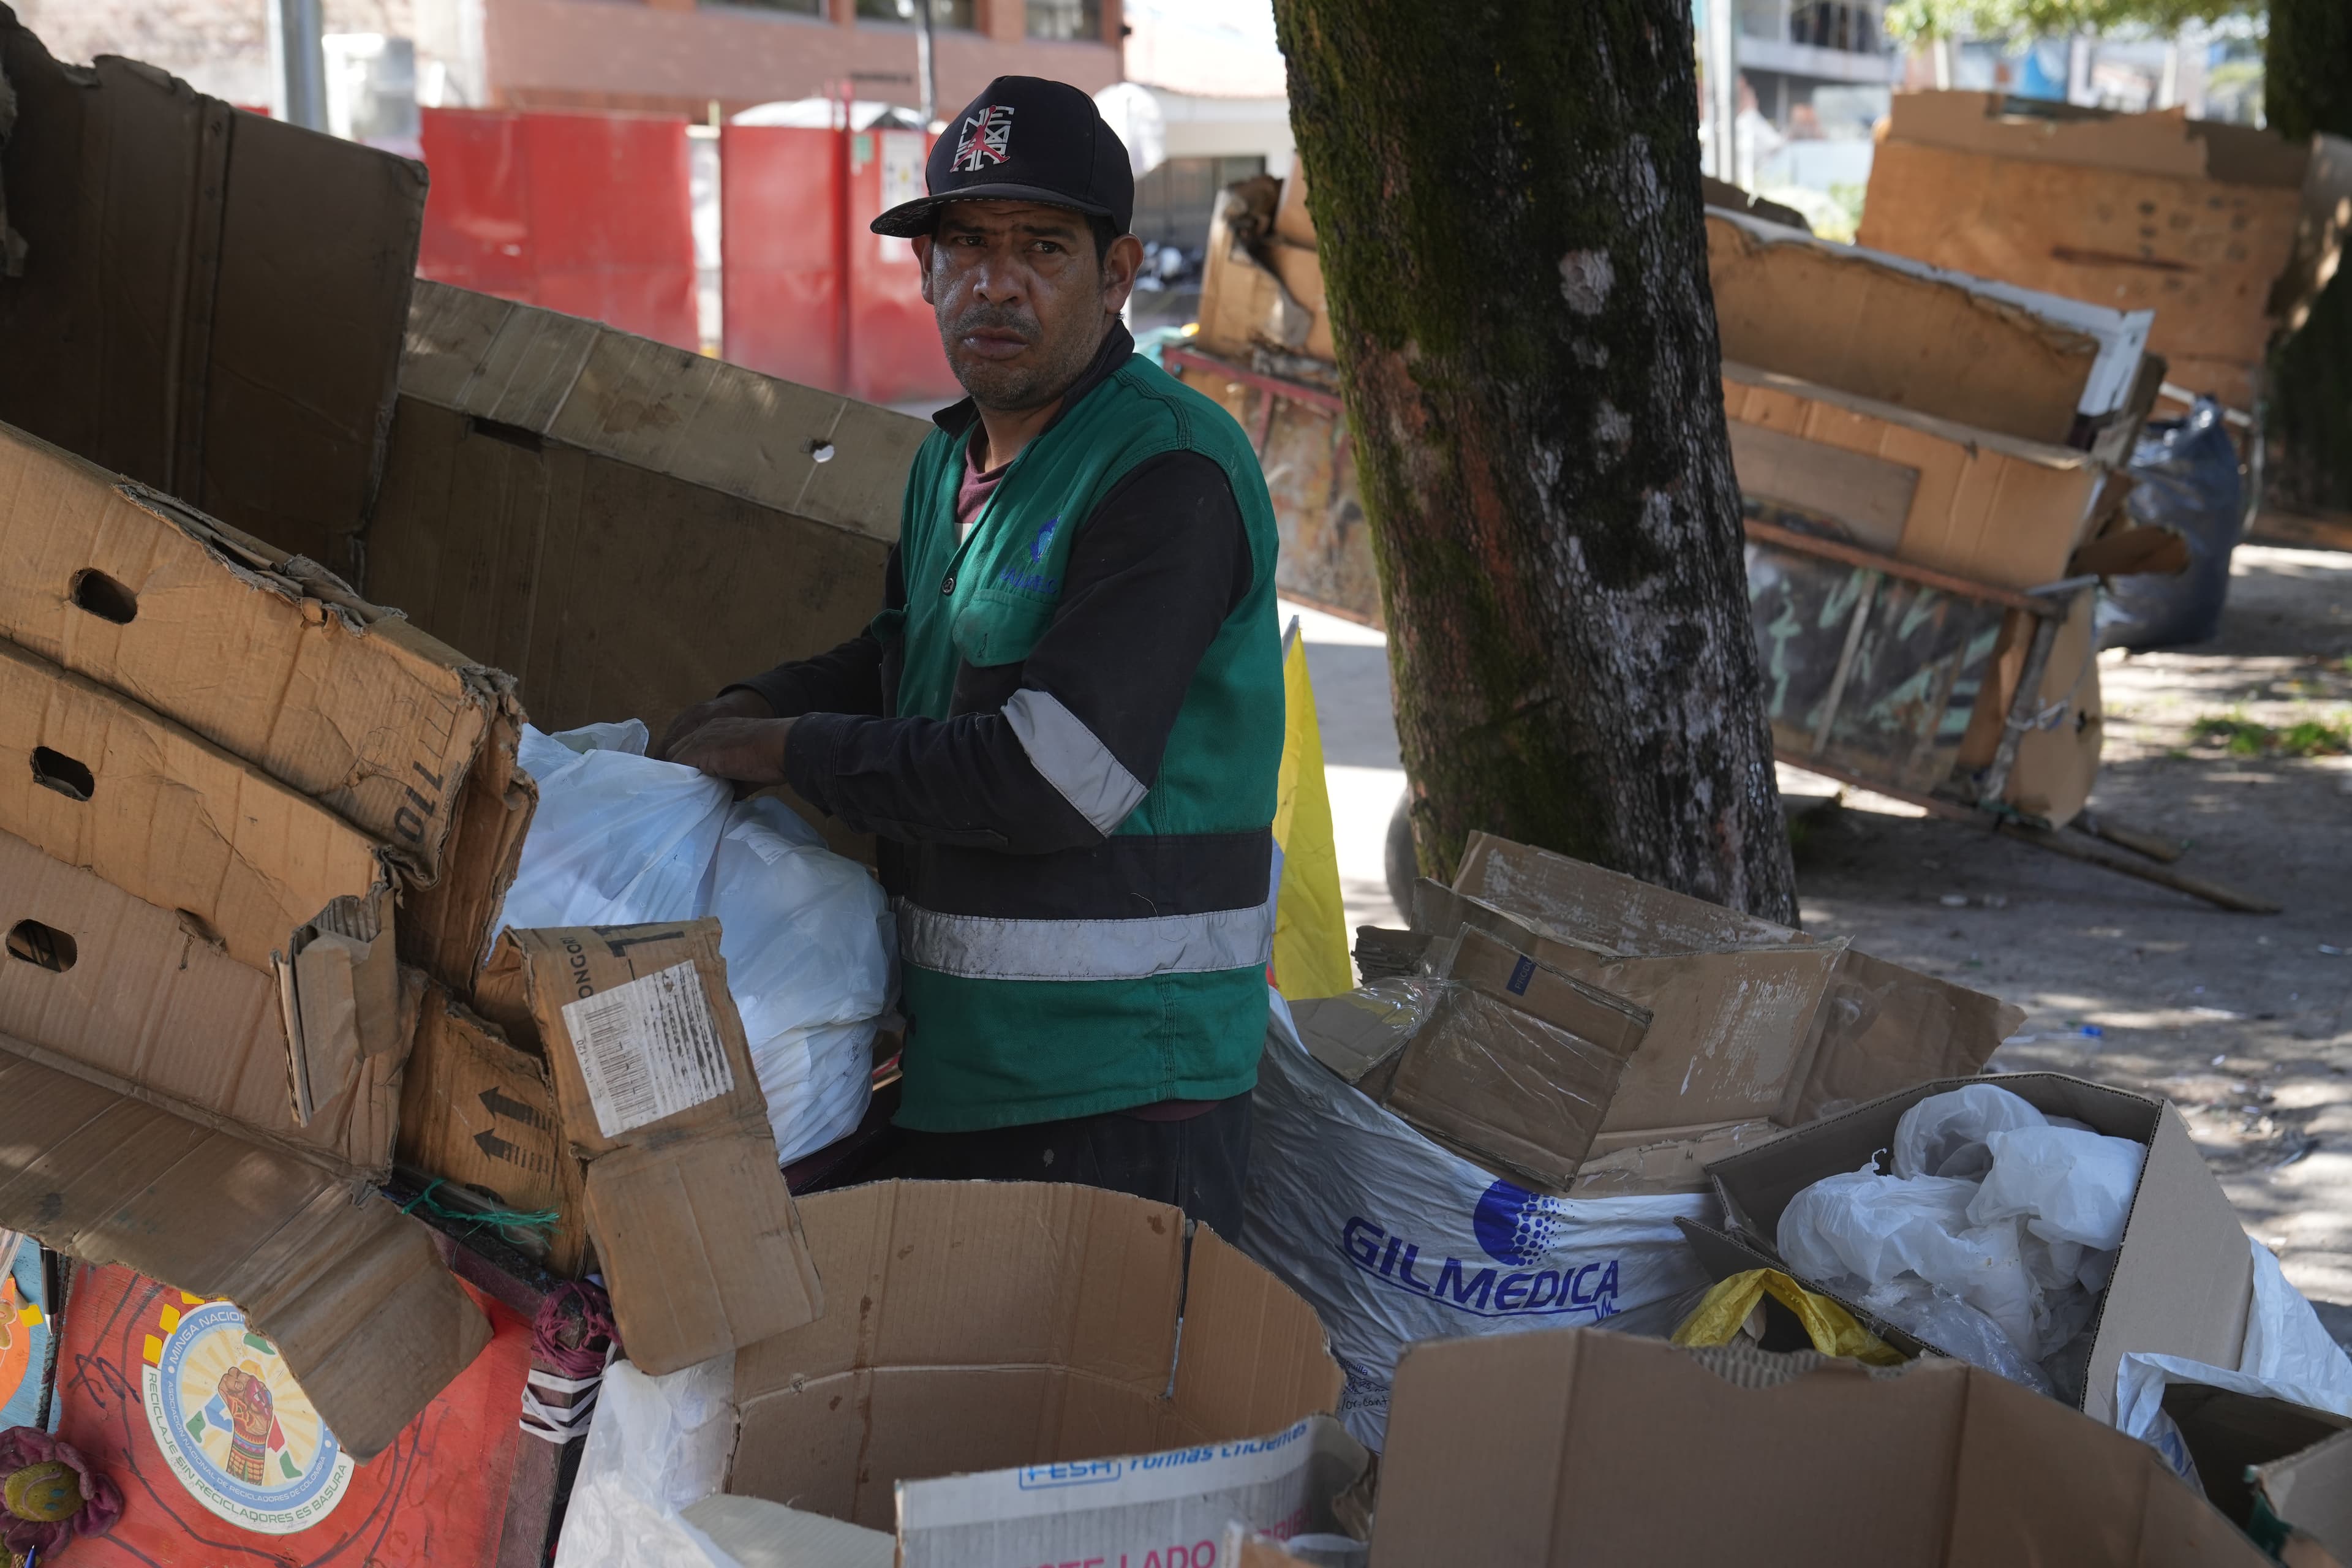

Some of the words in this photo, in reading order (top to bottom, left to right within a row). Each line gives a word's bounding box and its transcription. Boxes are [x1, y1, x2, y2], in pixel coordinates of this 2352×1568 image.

[1343, 1216, 1618, 1311] GILMEDICA
[169, 1324, 200, 1364] MINGA
[149, 1372, 178, 1455] RECICLAJE
[175, 1457, 195, 1480] SIN
[195, 1479, 294, 1523] RECICLADORES
[295, 1506, 312, 1519] ES
[311, 1464, 347, 1511] BASURA
[168, 1381, 184, 1437] ASOCIACION
[183, 1438, 215, 1479] NACIONAL
[216, 1477, 228, 1488] DE
[228, 1485, 290, 1502] RECICLADORES
[300, 1456, 326, 1491] COLOMBIA
